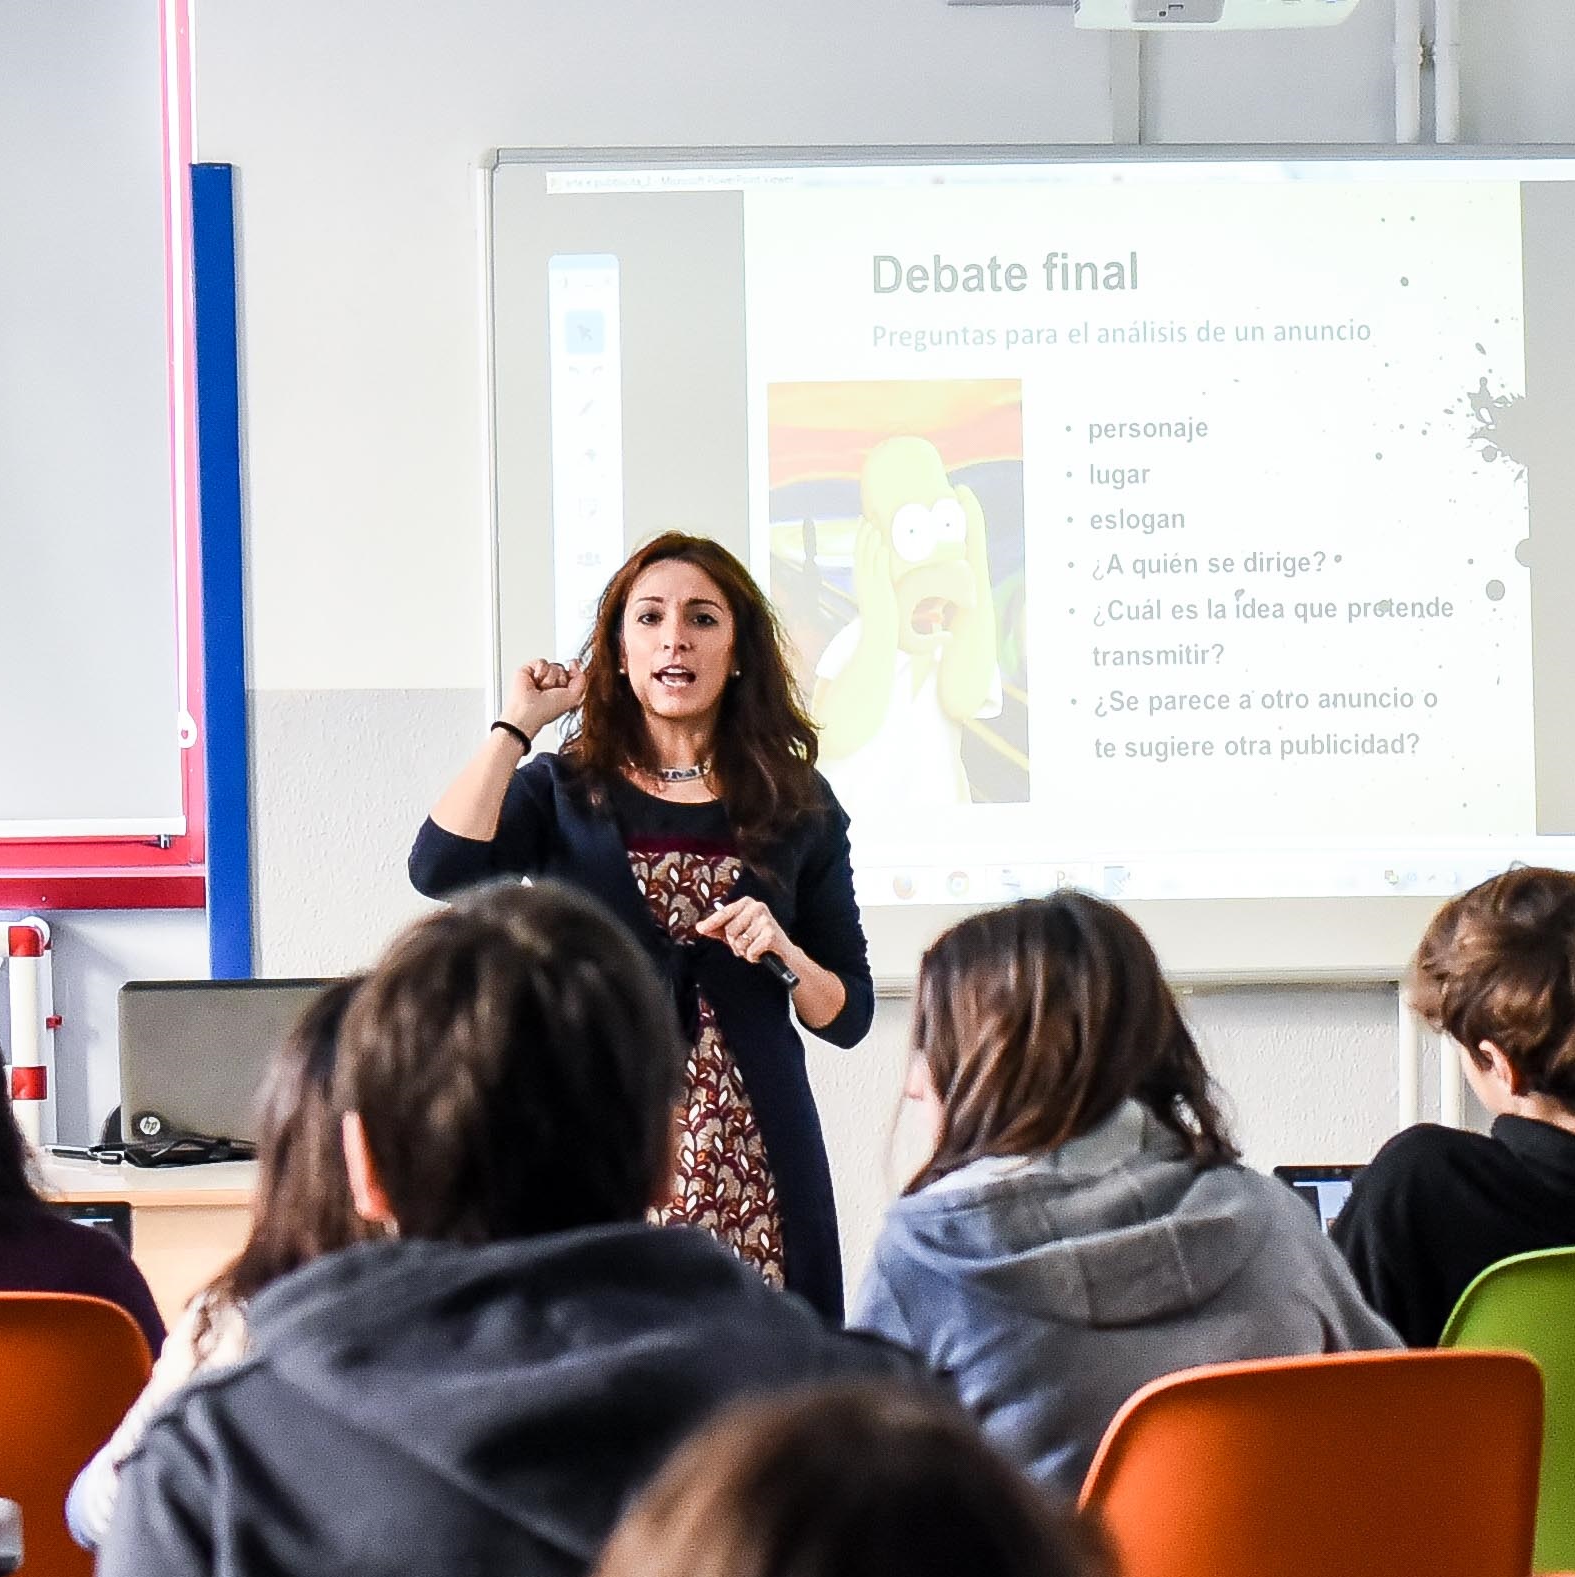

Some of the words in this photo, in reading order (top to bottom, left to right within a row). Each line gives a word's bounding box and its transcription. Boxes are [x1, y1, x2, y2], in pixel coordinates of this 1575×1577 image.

[873, 254, 1027, 294] Debate
[1041, 250, 1139, 291] final
[873, 325, 998, 352] Preguntas
[1005, 327, 1059, 351] para
[1067, 320, 1089, 344] el
[1097, 319, 1188, 344] análisis
[1197, 320, 1226, 342] de
[1235, 325, 1265, 342] un
[1274, 318, 1372, 342] anuncio
[1087, 416, 1209, 444] personaje
[1088, 463, 1151, 490] lugar
[1089, 508, 1186, 535] eslogan
[1092, 553, 1124, 582] ¿A
[1132, 552, 1198, 579] quién
[1207, 557, 1235, 573] se
[1243, 551, 1327, 578] dirige?
[1092, 598, 1161, 628] ¿Cuál
[1171, 603, 1198, 620] es
[1206, 599, 1226, 620] la
[1235, 598, 1285, 620] idea
[1294, 601, 1338, 624] que
[1093, 643, 1225, 667] transmitir?
[1094, 689, 1139, 719] ¿Se
[1148, 693, 1230, 717] parece
[1238, 694, 1252, 710] a
[1260, 689, 1310, 710] otro
[1318, 687, 1415, 710] anuncio
[1423, 691, 1438, 709] o
[1094, 738, 1117, 759] te
[1124, 736, 1215, 764] sugiere
[1224, 735, 1272, 756] otra
[1279, 732, 1421, 761] publicidad?
